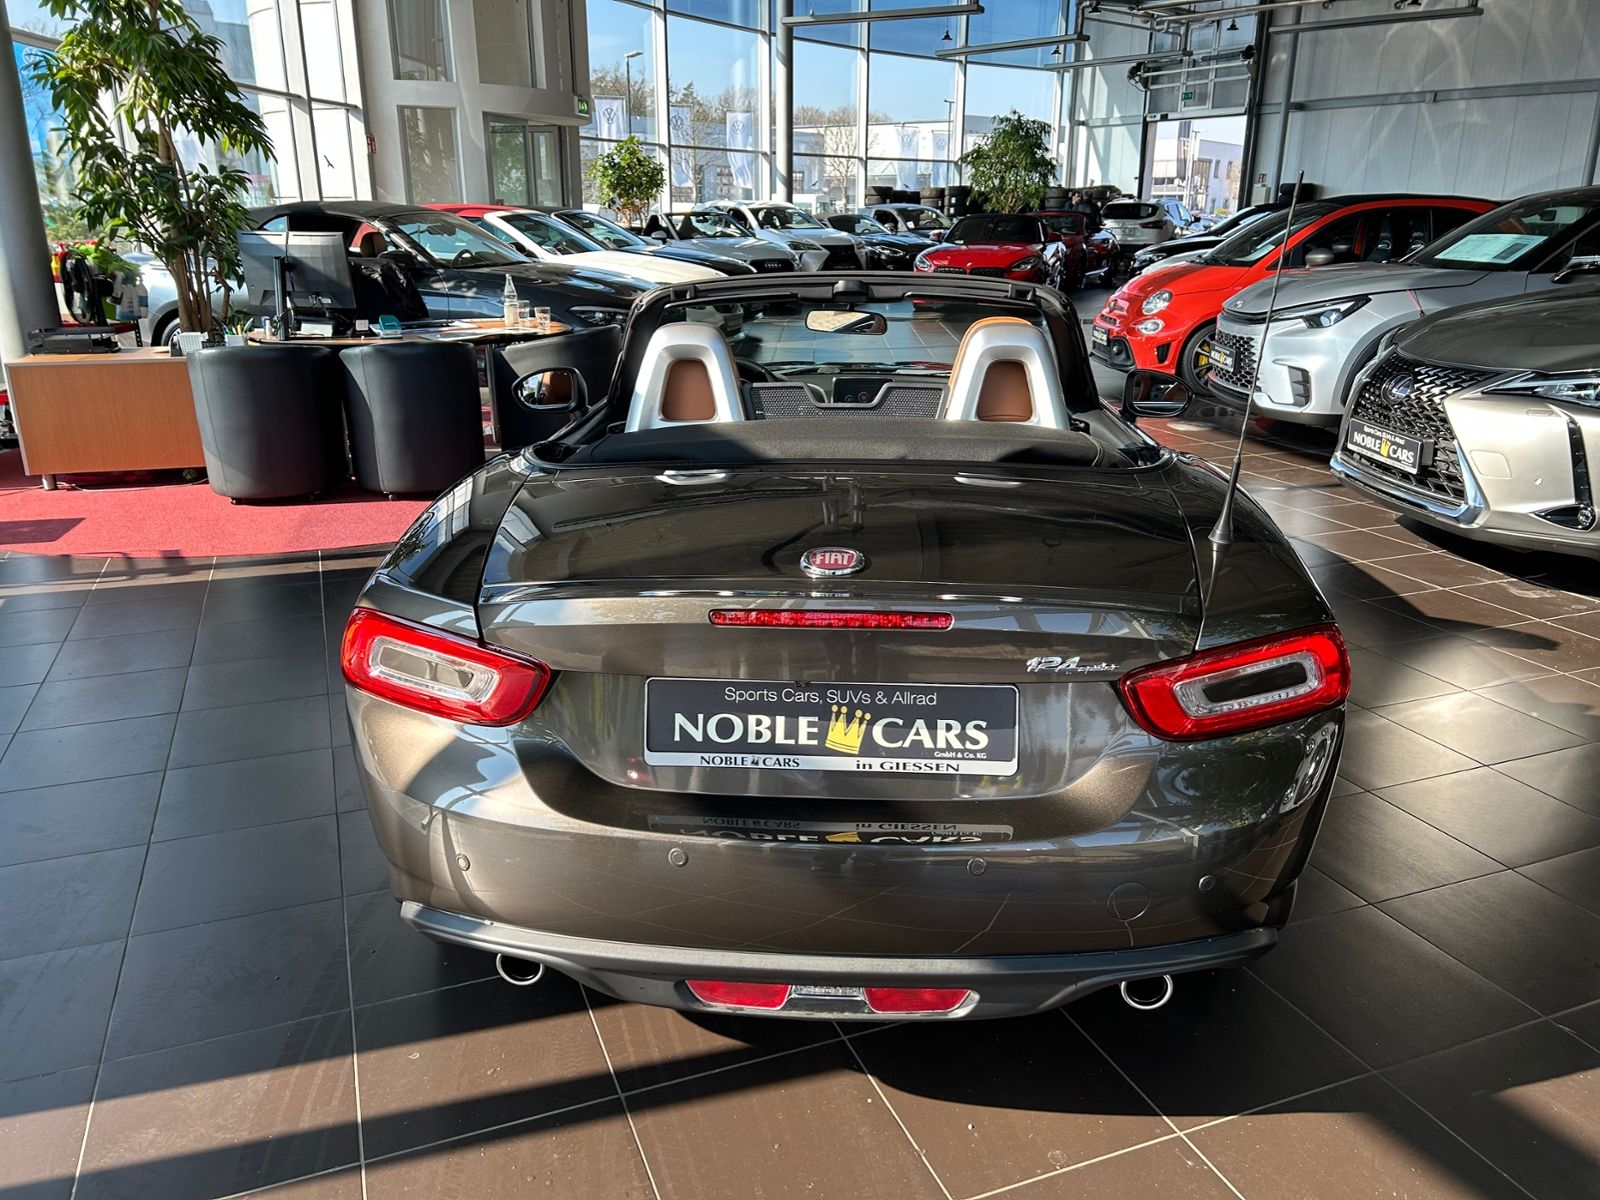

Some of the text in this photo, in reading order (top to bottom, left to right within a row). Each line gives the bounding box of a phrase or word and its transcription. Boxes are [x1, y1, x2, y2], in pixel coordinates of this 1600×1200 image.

[1353, 431, 1381, 452] NOBLE
[1389, 445, 1414, 463] CARS
[815, 552, 852, 565] FIAT
[724, 686, 938, 705] Sports Cars, SUVs & Allrad
[673, 712, 989, 750] NOBLE CARS
[700, 755, 800, 768] NOBLE CARS
[855, 760, 960, 772] in GIESSEN
